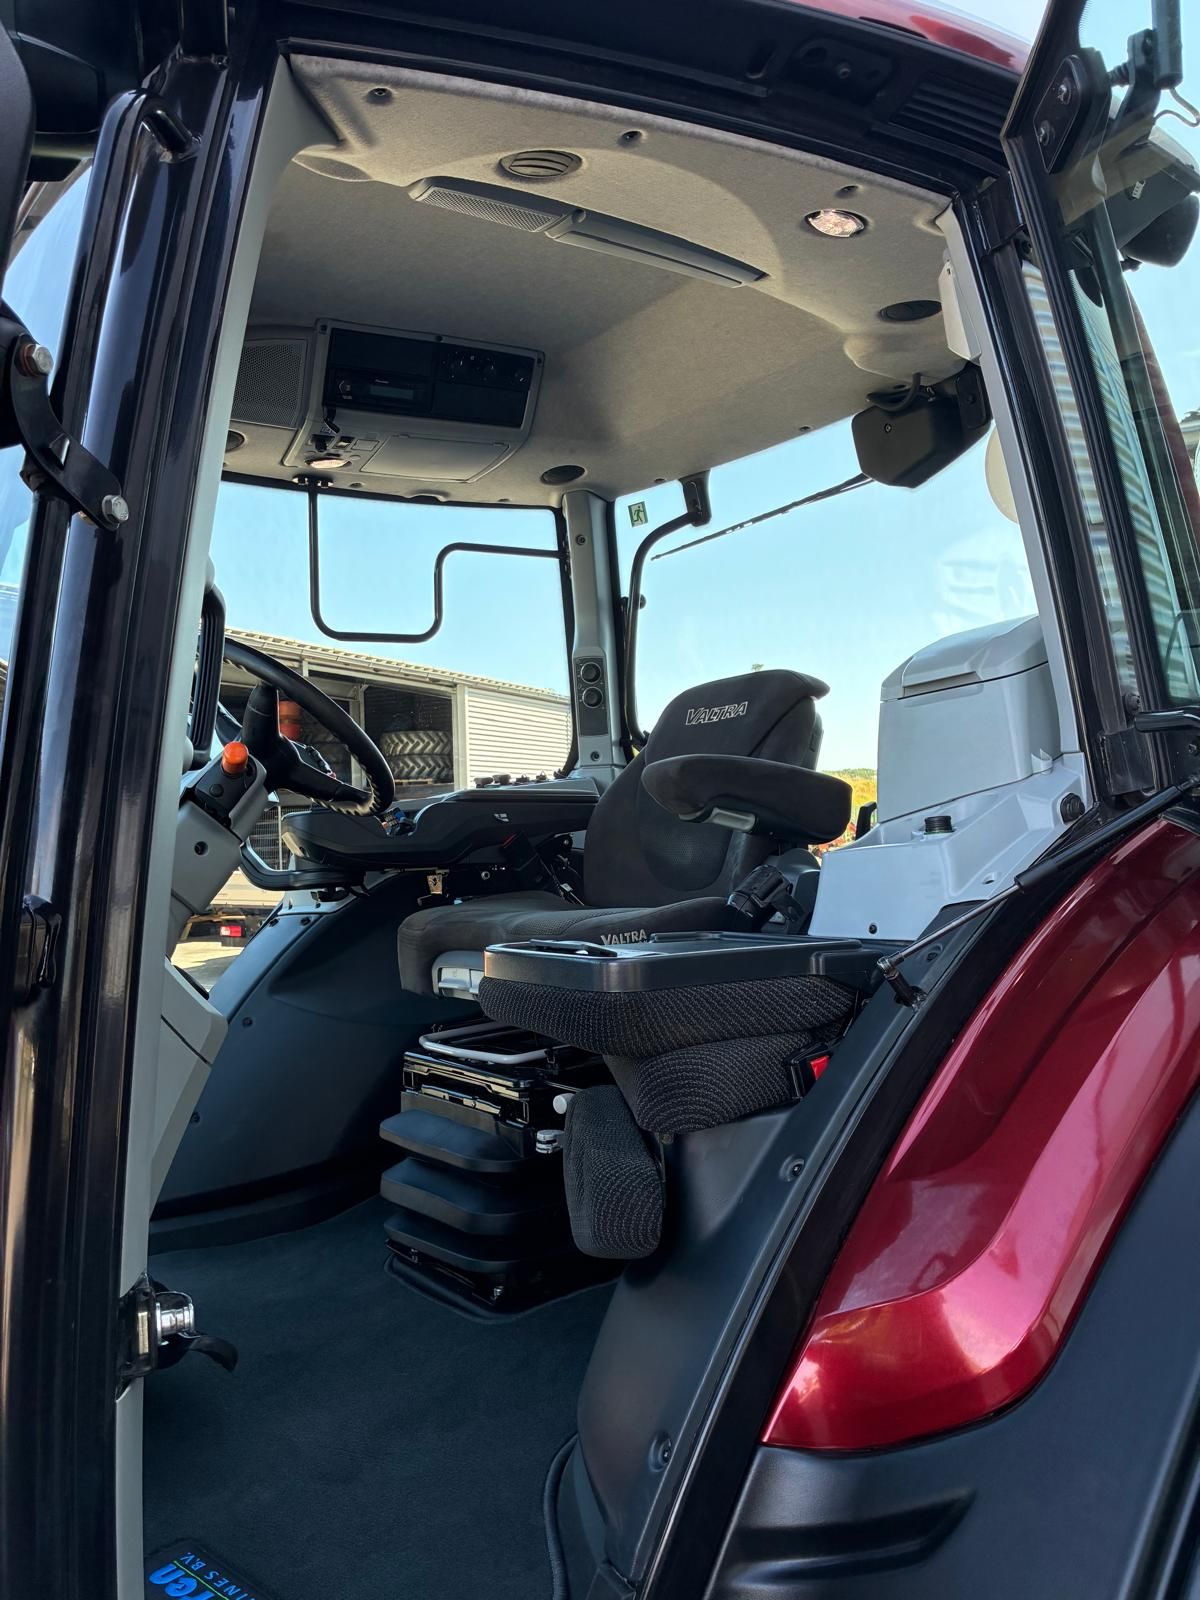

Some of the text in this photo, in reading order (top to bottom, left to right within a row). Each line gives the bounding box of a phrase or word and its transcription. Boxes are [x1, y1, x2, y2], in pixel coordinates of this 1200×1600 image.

[685, 701, 748, 725] VALTRA
[600, 929, 647, 945] VALTRA
[204, 1570, 256, 1600] INES
